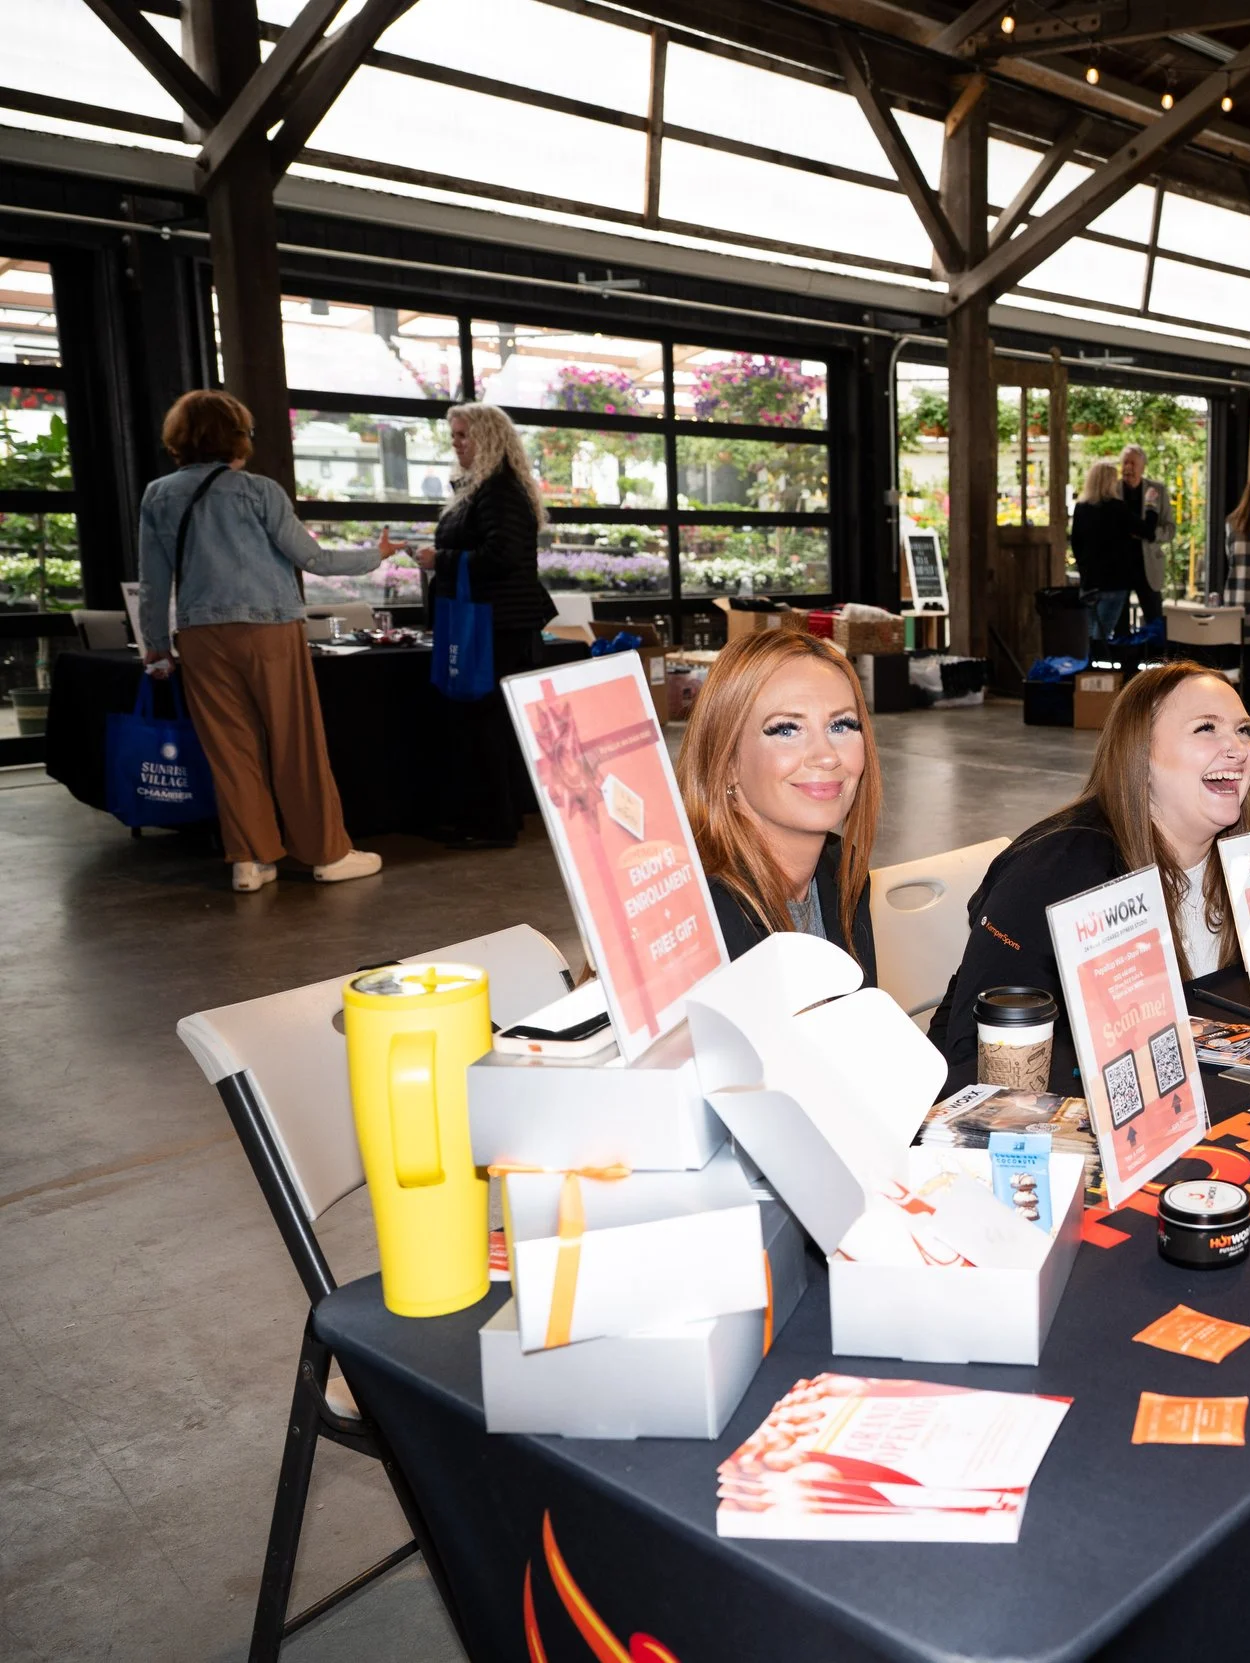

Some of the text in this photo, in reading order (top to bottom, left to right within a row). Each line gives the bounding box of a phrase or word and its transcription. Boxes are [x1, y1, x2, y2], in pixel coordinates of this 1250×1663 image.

[136, 787, 193, 800] CHAMBER
[141, 772, 189, 788] VILLAGE
[623, 864, 692, 920] ENROLLMENT
[629, 855, 663, 888] ENJOY
[649, 930, 679, 961] FREE
[674, 914, 698, 942] GIFT
[1075, 893, 1149, 942] HOTWORX
[1103, 992, 1168, 1048] Scan me!
[845, 1402, 902, 1452] GRAND
[871, 1399, 940, 1464] OPENING
